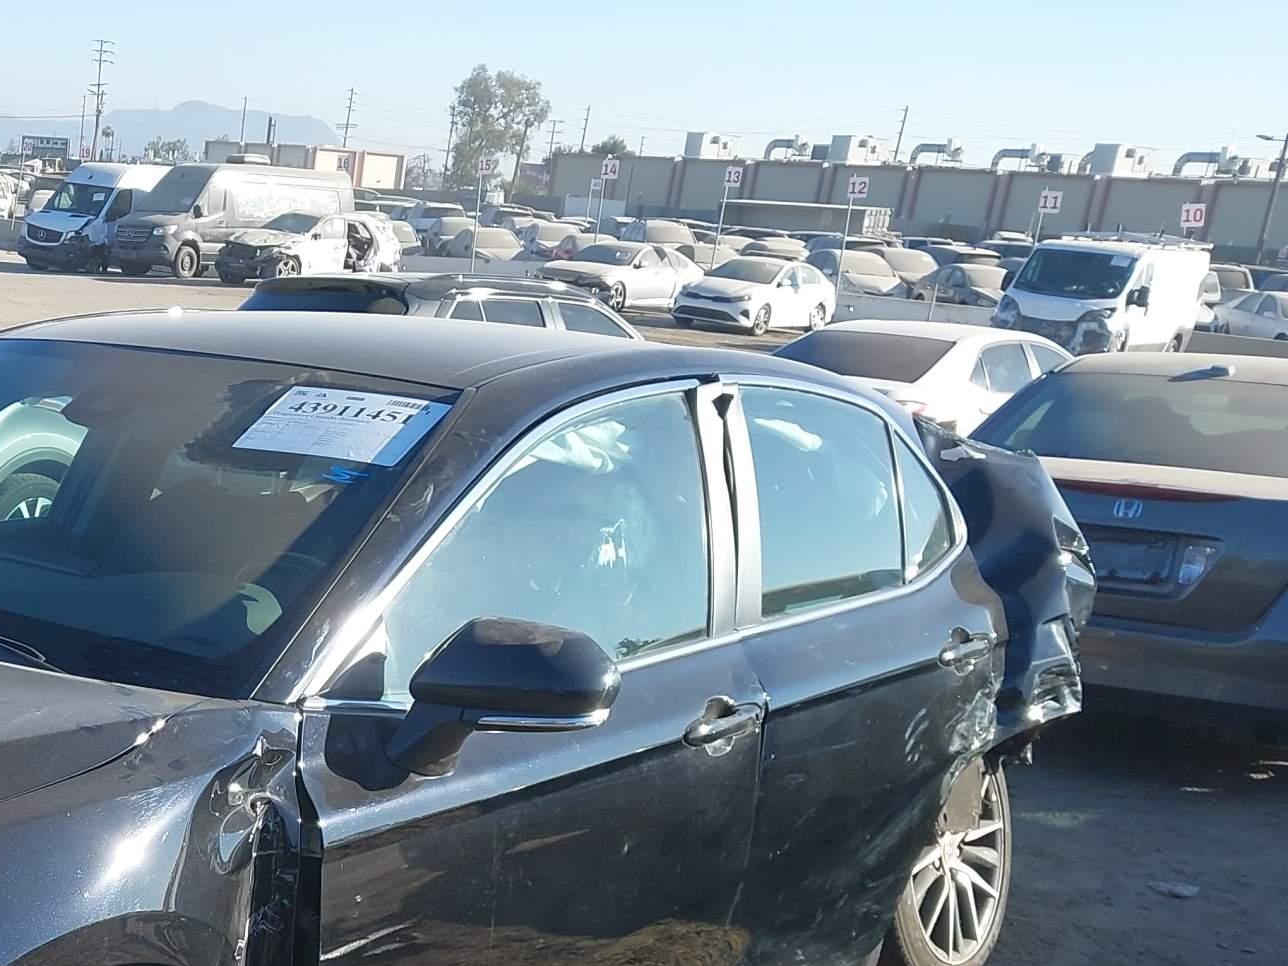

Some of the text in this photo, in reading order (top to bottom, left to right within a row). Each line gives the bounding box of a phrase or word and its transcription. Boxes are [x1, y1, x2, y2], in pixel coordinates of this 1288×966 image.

[23, 141, 32, 152] 20
[81, 148, 90, 158] 19
[338, 158, 350, 169] 16
[479, 160, 491, 171] 15
[602, 163, 617, 176] 14
[725, 171, 740, 183] 13
[849, 181, 867, 194] 12
[1040, 195, 1058, 209] 11
[1183, 208, 1203, 222] 10
[288, 401, 414, 424] 43911451
